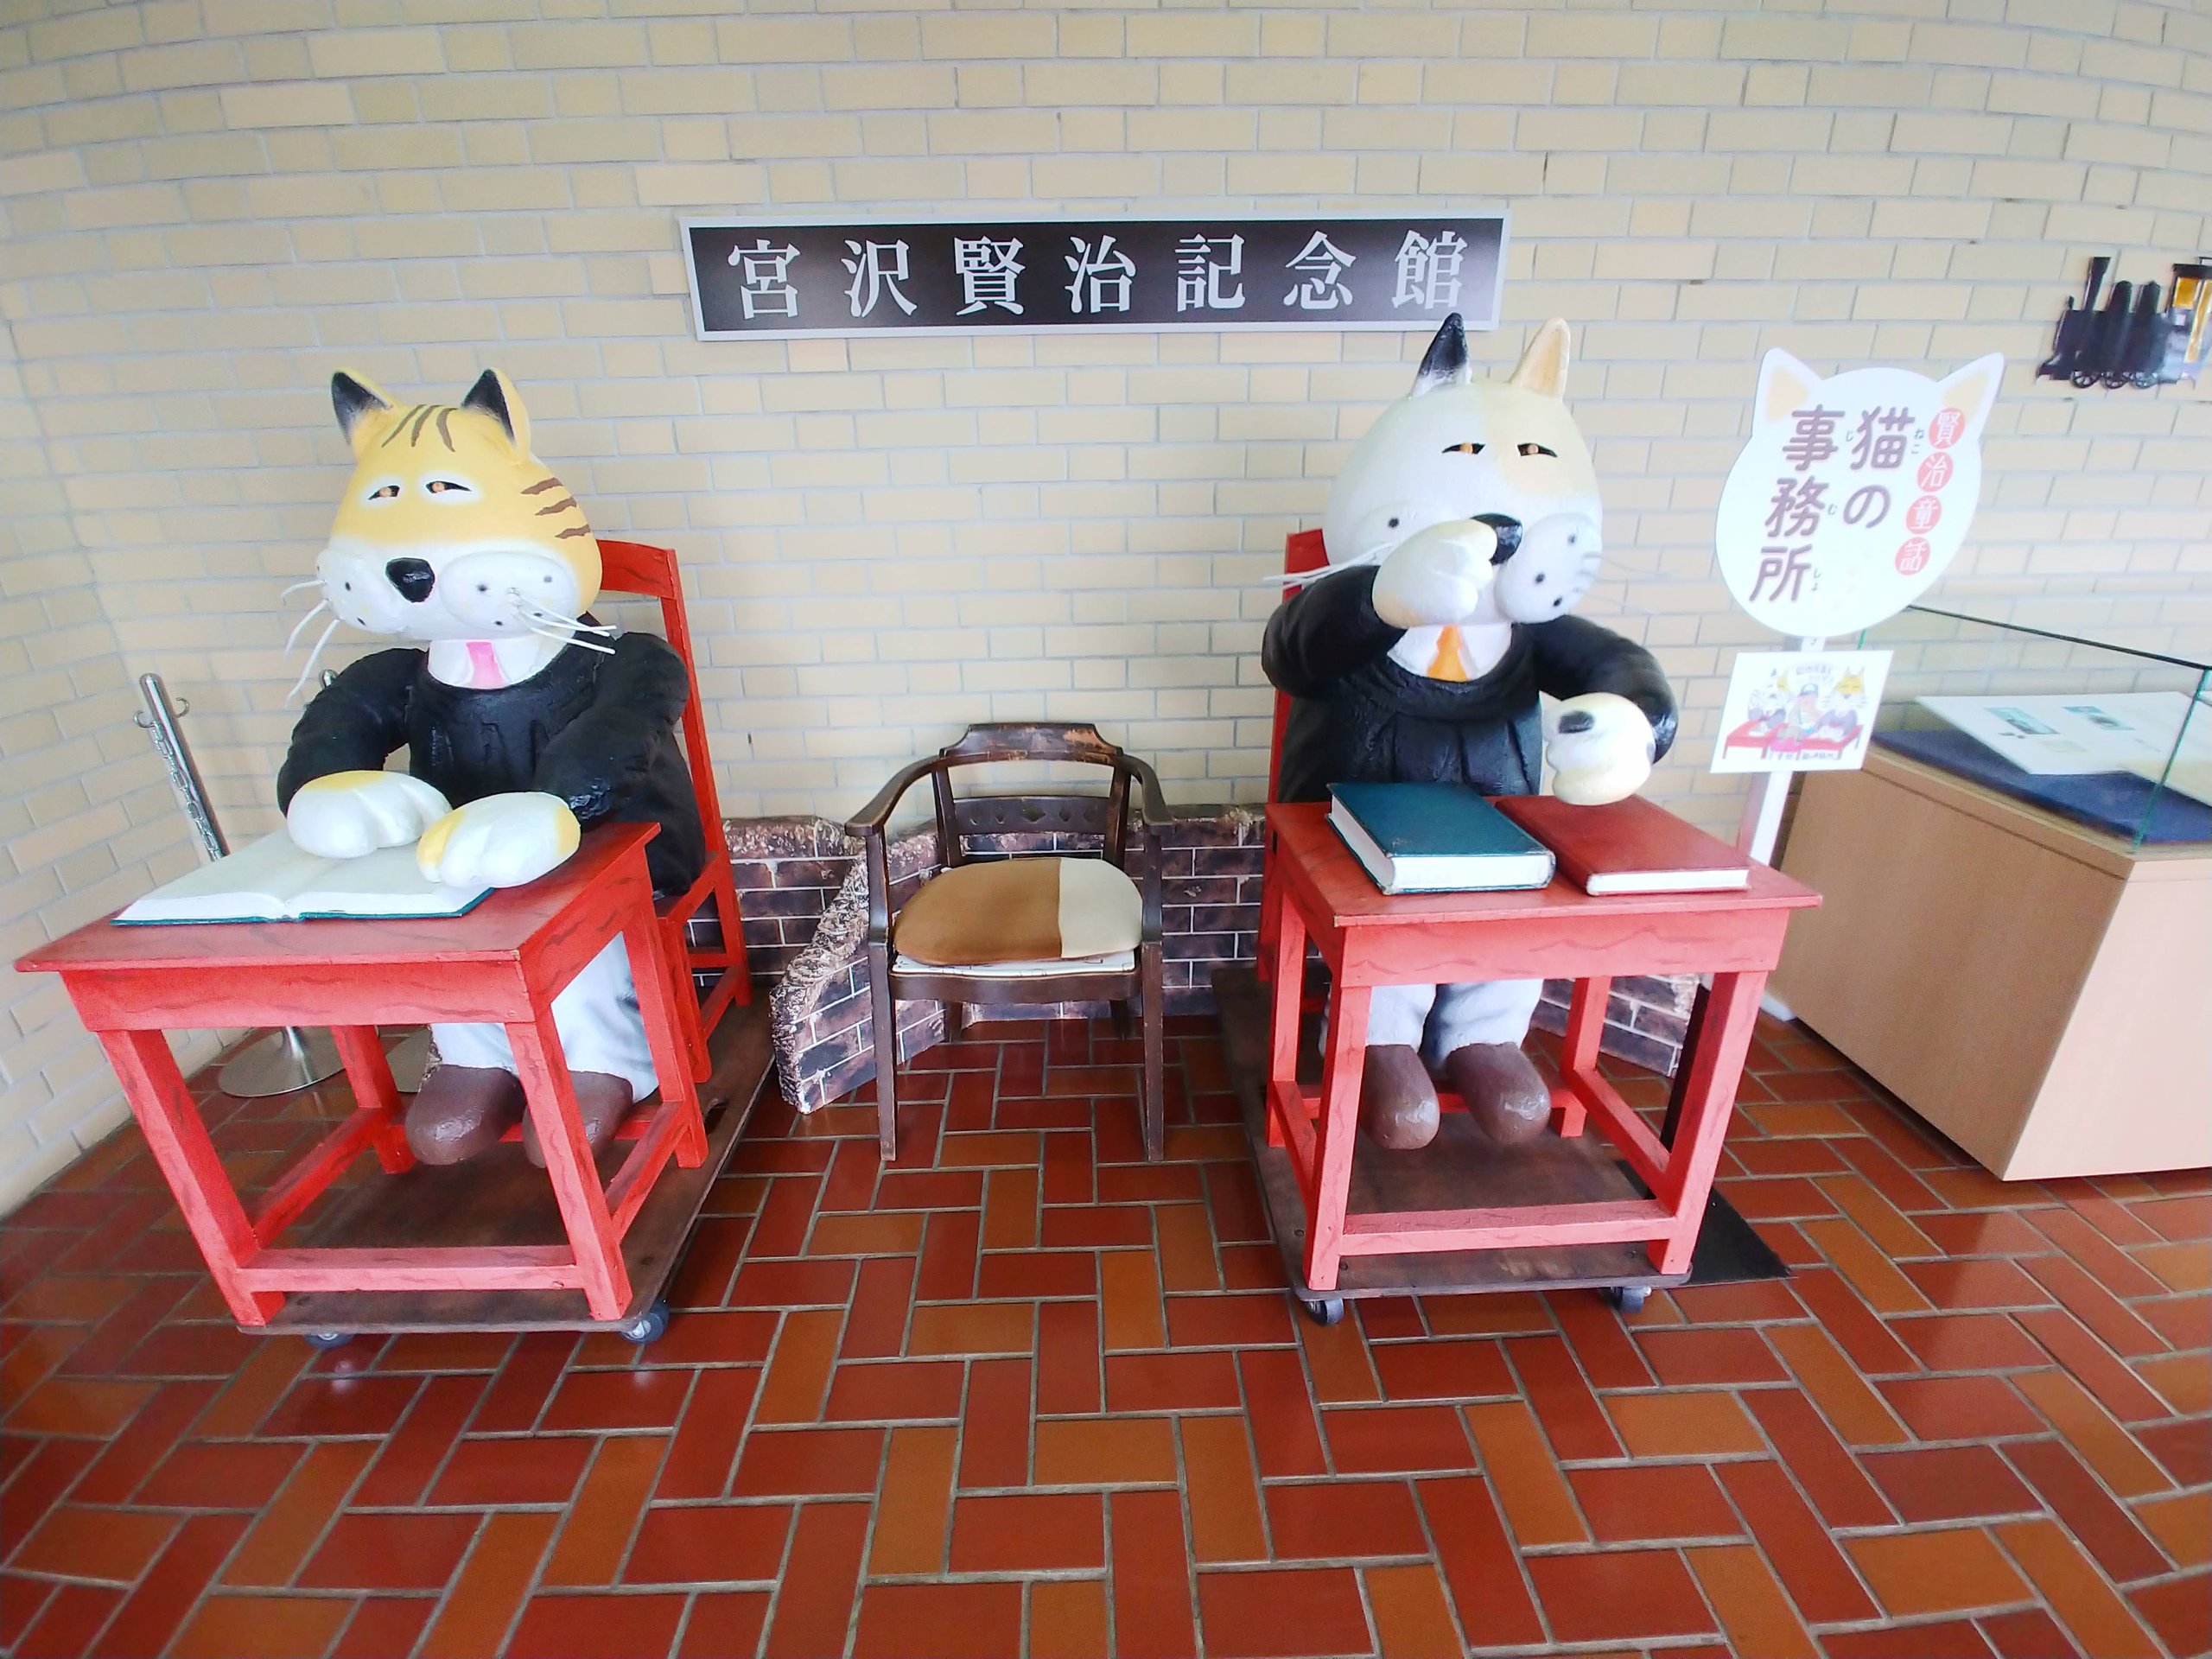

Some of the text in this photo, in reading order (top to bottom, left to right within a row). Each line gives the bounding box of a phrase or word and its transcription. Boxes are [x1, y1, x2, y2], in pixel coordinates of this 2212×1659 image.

[727, 229, 1466, 319] 宮沢賢治記念館
[1748, 404, 1846, 602] 事務所
[1842, 405, 1916, 529] 猫の
[1897, 410, 1961, 573] 賢治童話
[1910, 428, 1926, 454] ねこ
